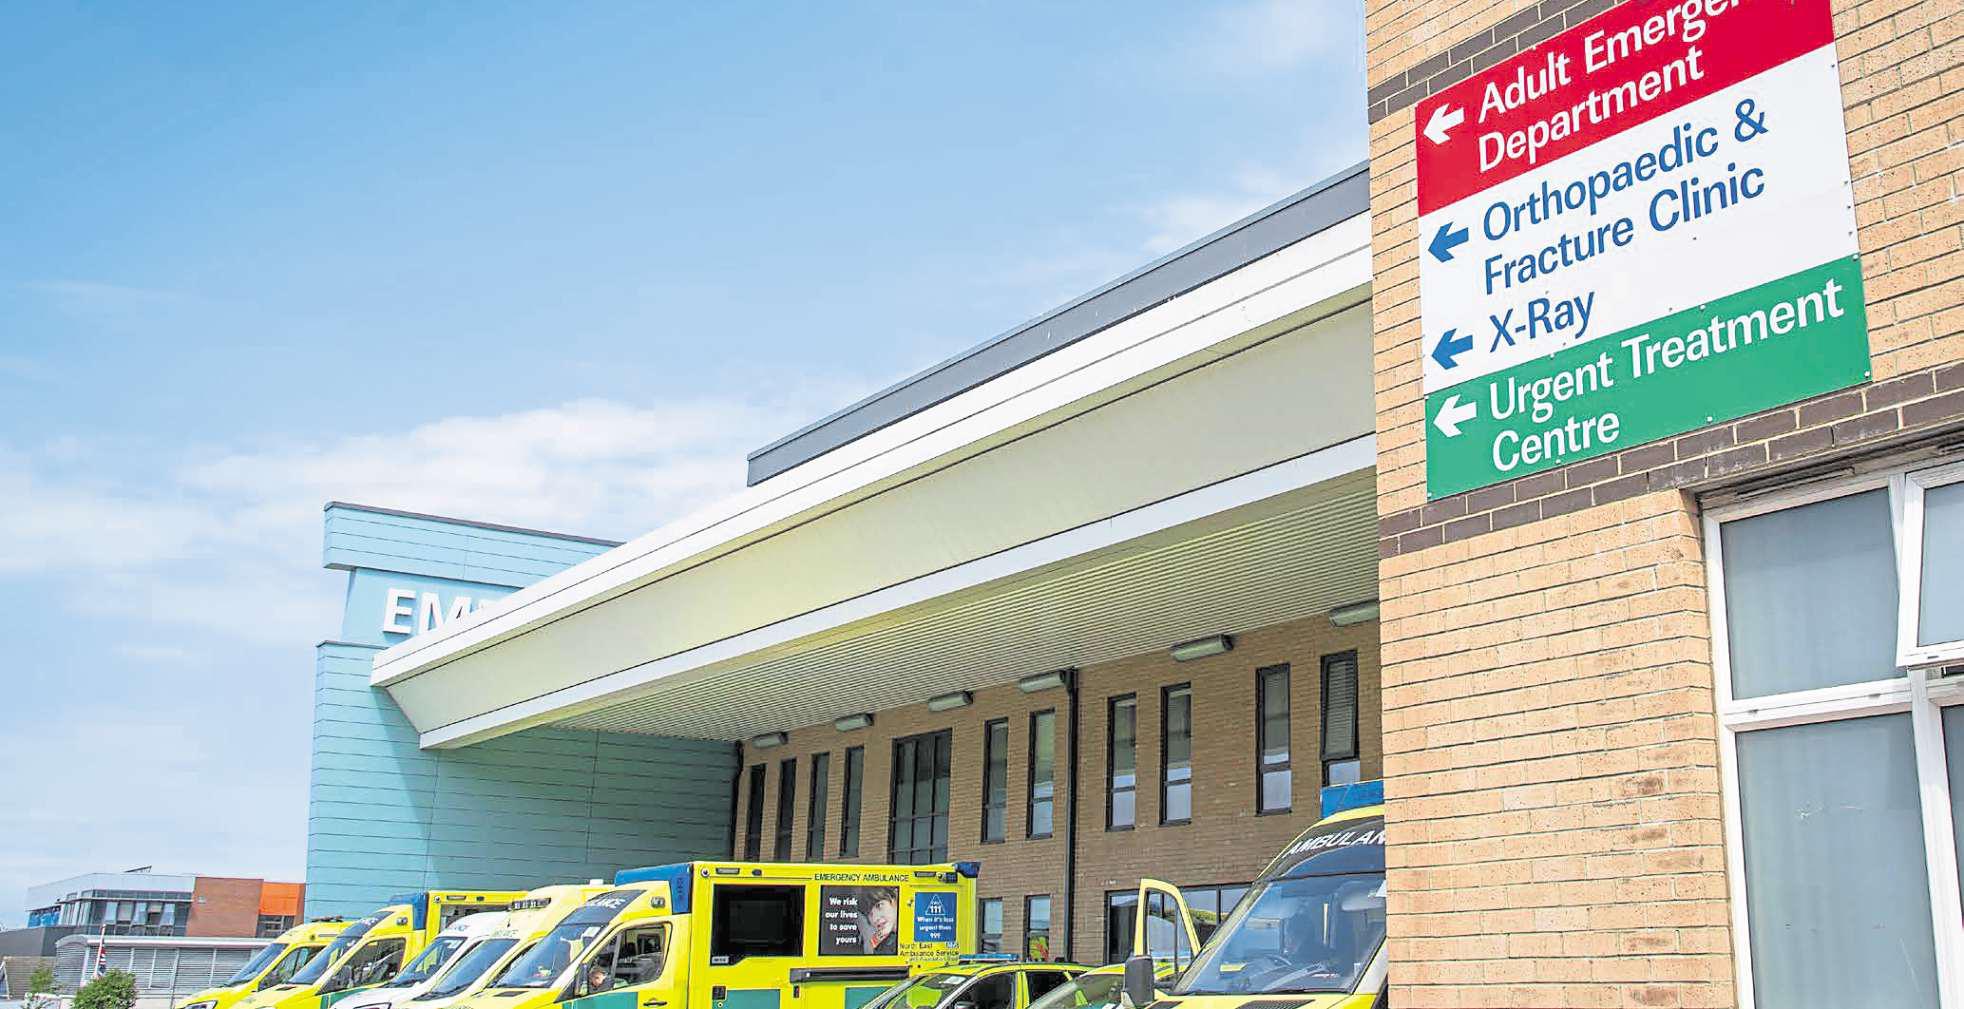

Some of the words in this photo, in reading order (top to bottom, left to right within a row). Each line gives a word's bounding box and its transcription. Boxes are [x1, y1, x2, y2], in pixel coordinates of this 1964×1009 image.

[1478, 52, 1572, 124] Adult
[1584, 0, 1741, 74] Emerge
[1478, 45, 1705, 173] Department
[1483, 122, 1718, 241] Orthopaedic
[1734, 98, 1769, 142] &
[1485, 216, 1634, 295] Fracture
[1649, 162, 1765, 232] Clinic
[1489, 291, 1595, 353] X-Ray
[1490, 352, 1614, 423] Urgent
[1621, 278, 1844, 379] Treatment
[1493, 412, 1620, 472] Centre
[383, 588, 489, 634] EM
[814, 873, 861, 882] EMERGENCY
[863, 874, 909, 882] AMBULANCE
[829, 897, 841, 906] We
[842, 896, 858, 906] risk
[829, 923, 837, 931] to
[840, 910, 858, 918] lives
[930, 905, 941, 913] 111
[836, 936, 857, 945] yours
